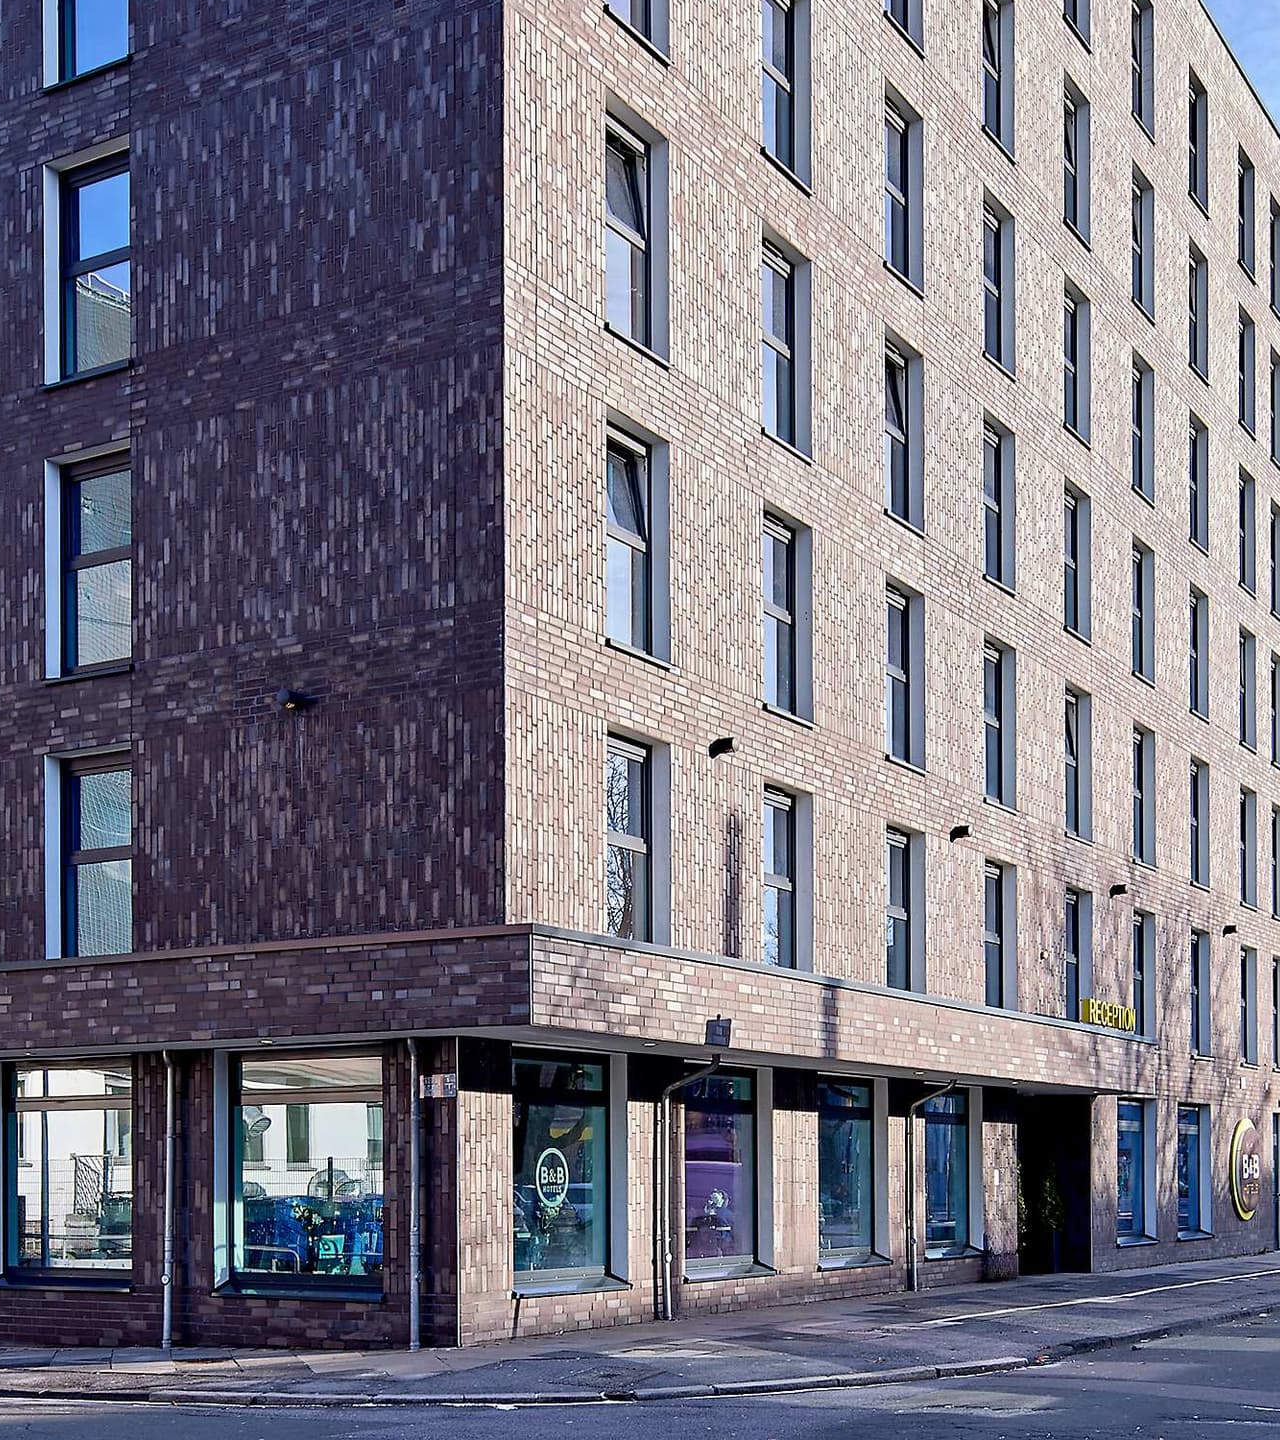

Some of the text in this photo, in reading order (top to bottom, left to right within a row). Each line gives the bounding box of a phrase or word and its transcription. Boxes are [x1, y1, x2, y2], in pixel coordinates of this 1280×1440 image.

[1090, 998, 1136, 1031] RECEPTION
[541, 1166, 565, 1184] B&B
[542, 1185, 562, 1193] HOTELS
